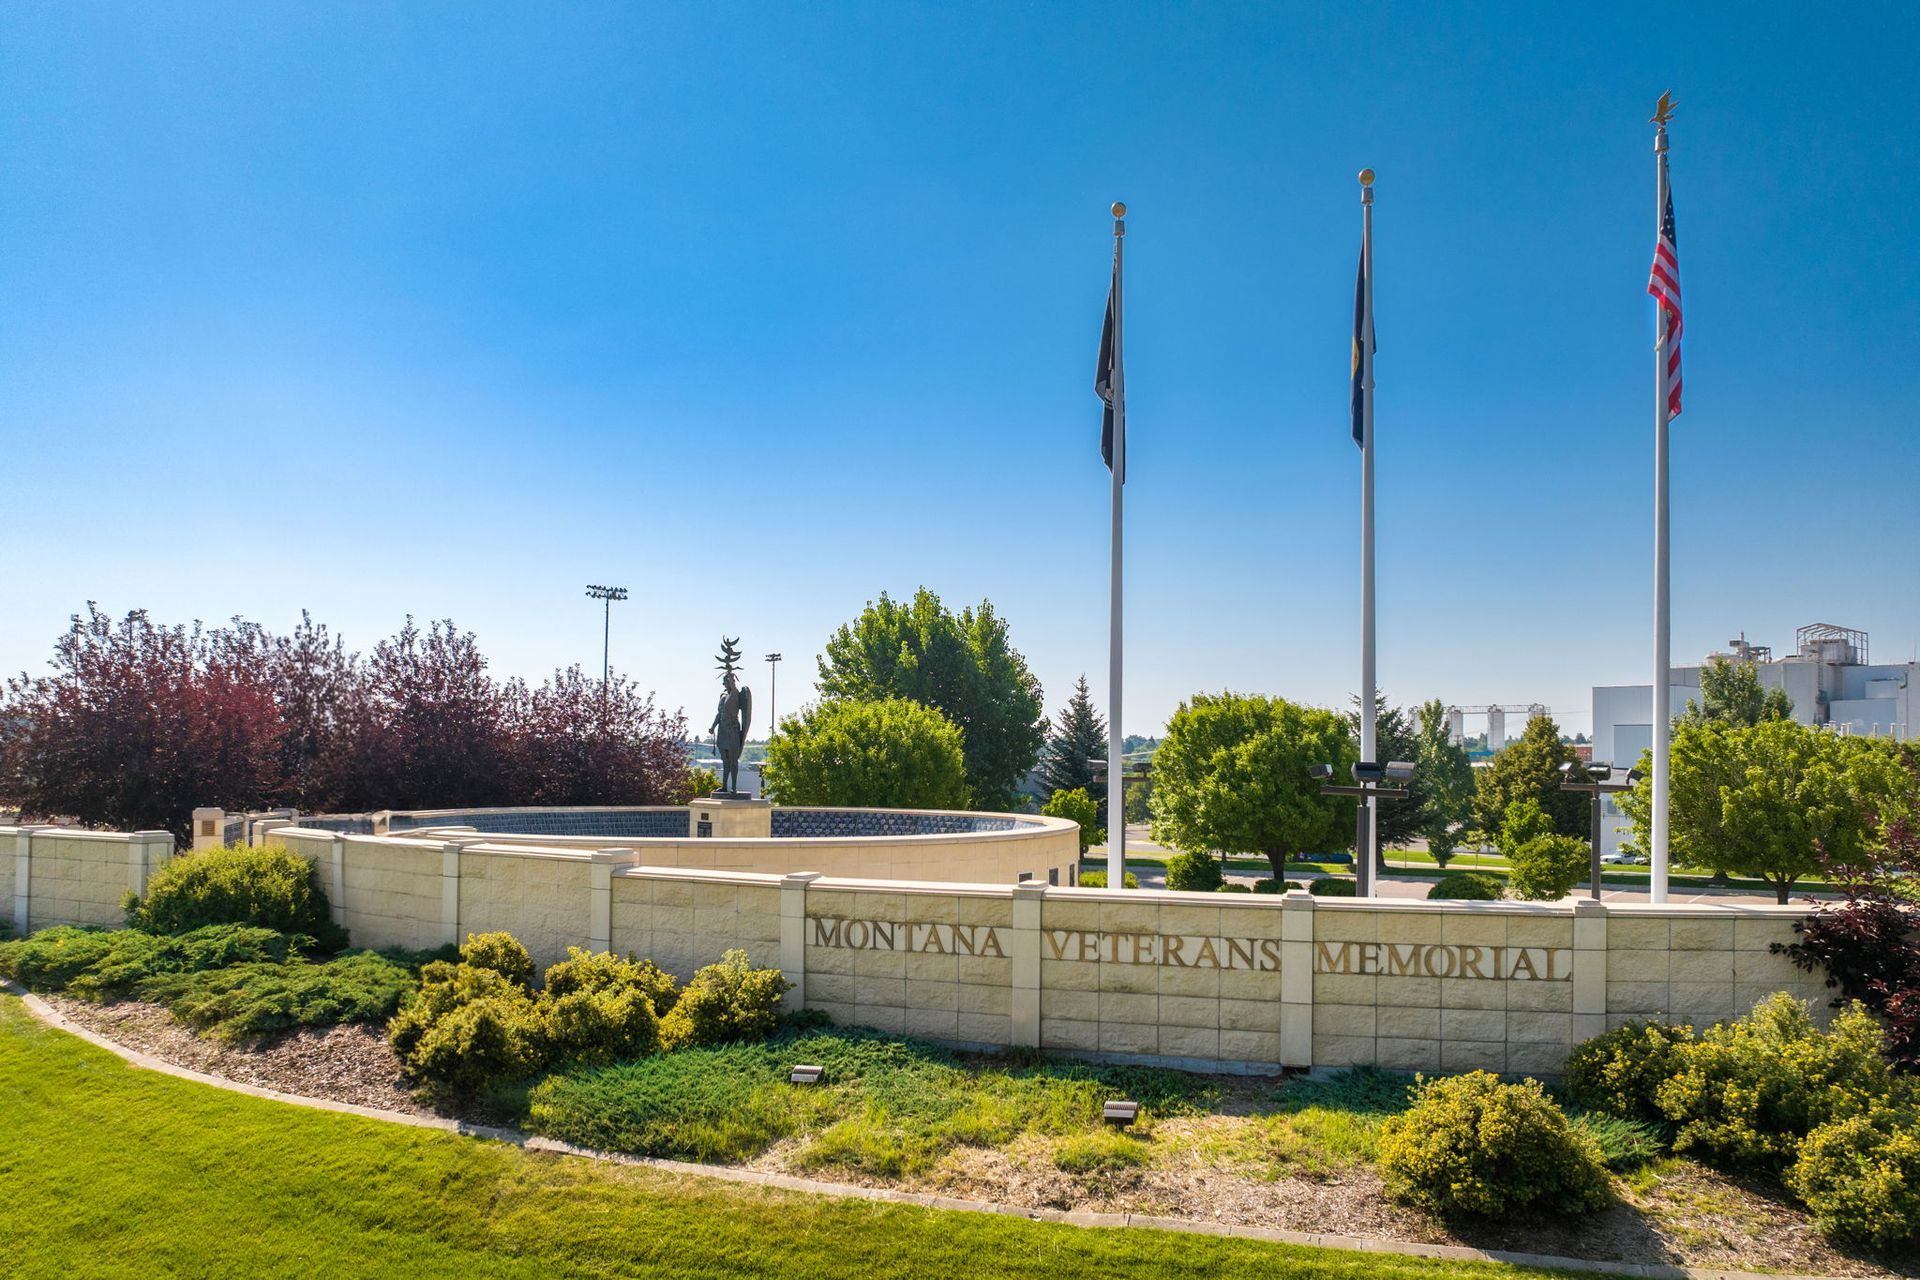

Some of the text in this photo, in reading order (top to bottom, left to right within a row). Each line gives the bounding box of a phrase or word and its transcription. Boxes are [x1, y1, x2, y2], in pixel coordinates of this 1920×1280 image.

[814, 918, 1572, 982] MONTANA VETERANS MEMORIAL
